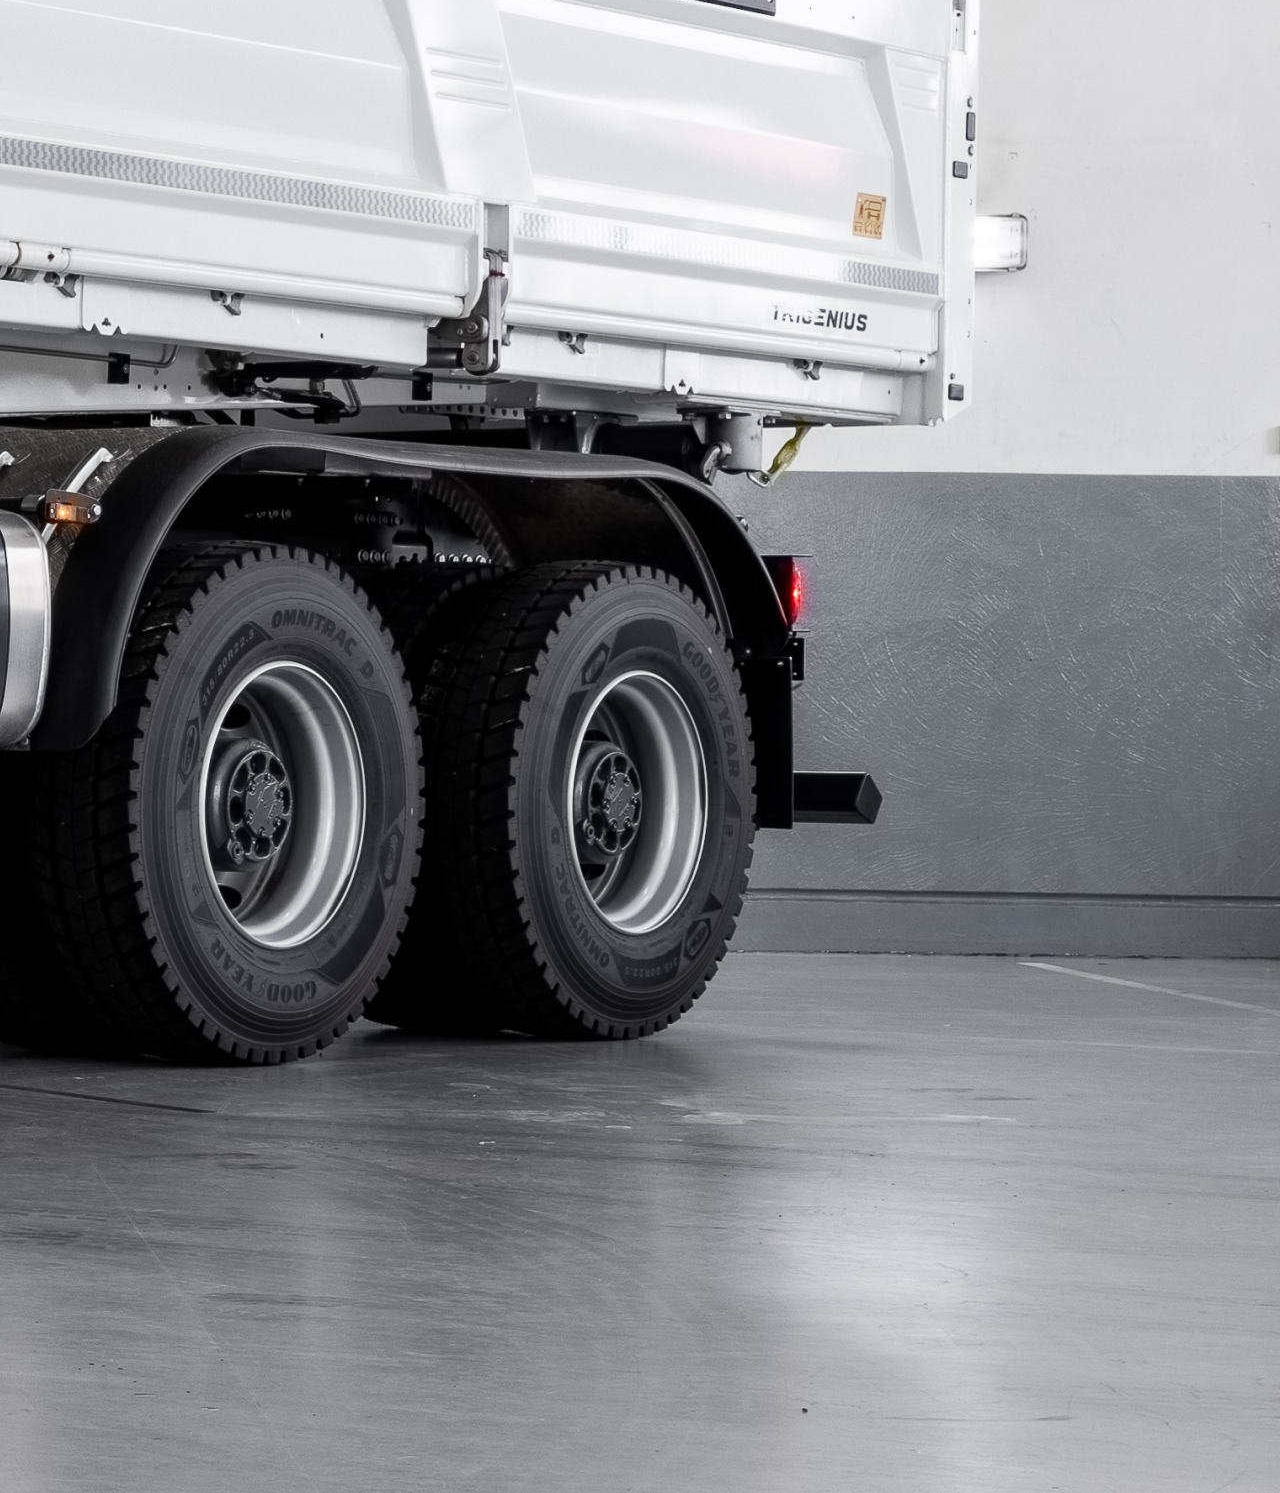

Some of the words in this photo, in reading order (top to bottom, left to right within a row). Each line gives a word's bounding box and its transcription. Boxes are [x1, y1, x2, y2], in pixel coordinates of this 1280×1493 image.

[271, 609, 358, 657] OMNITRAC
[359, 659, 374, 680] D
[556, 862, 610, 969] OMNITRAC
